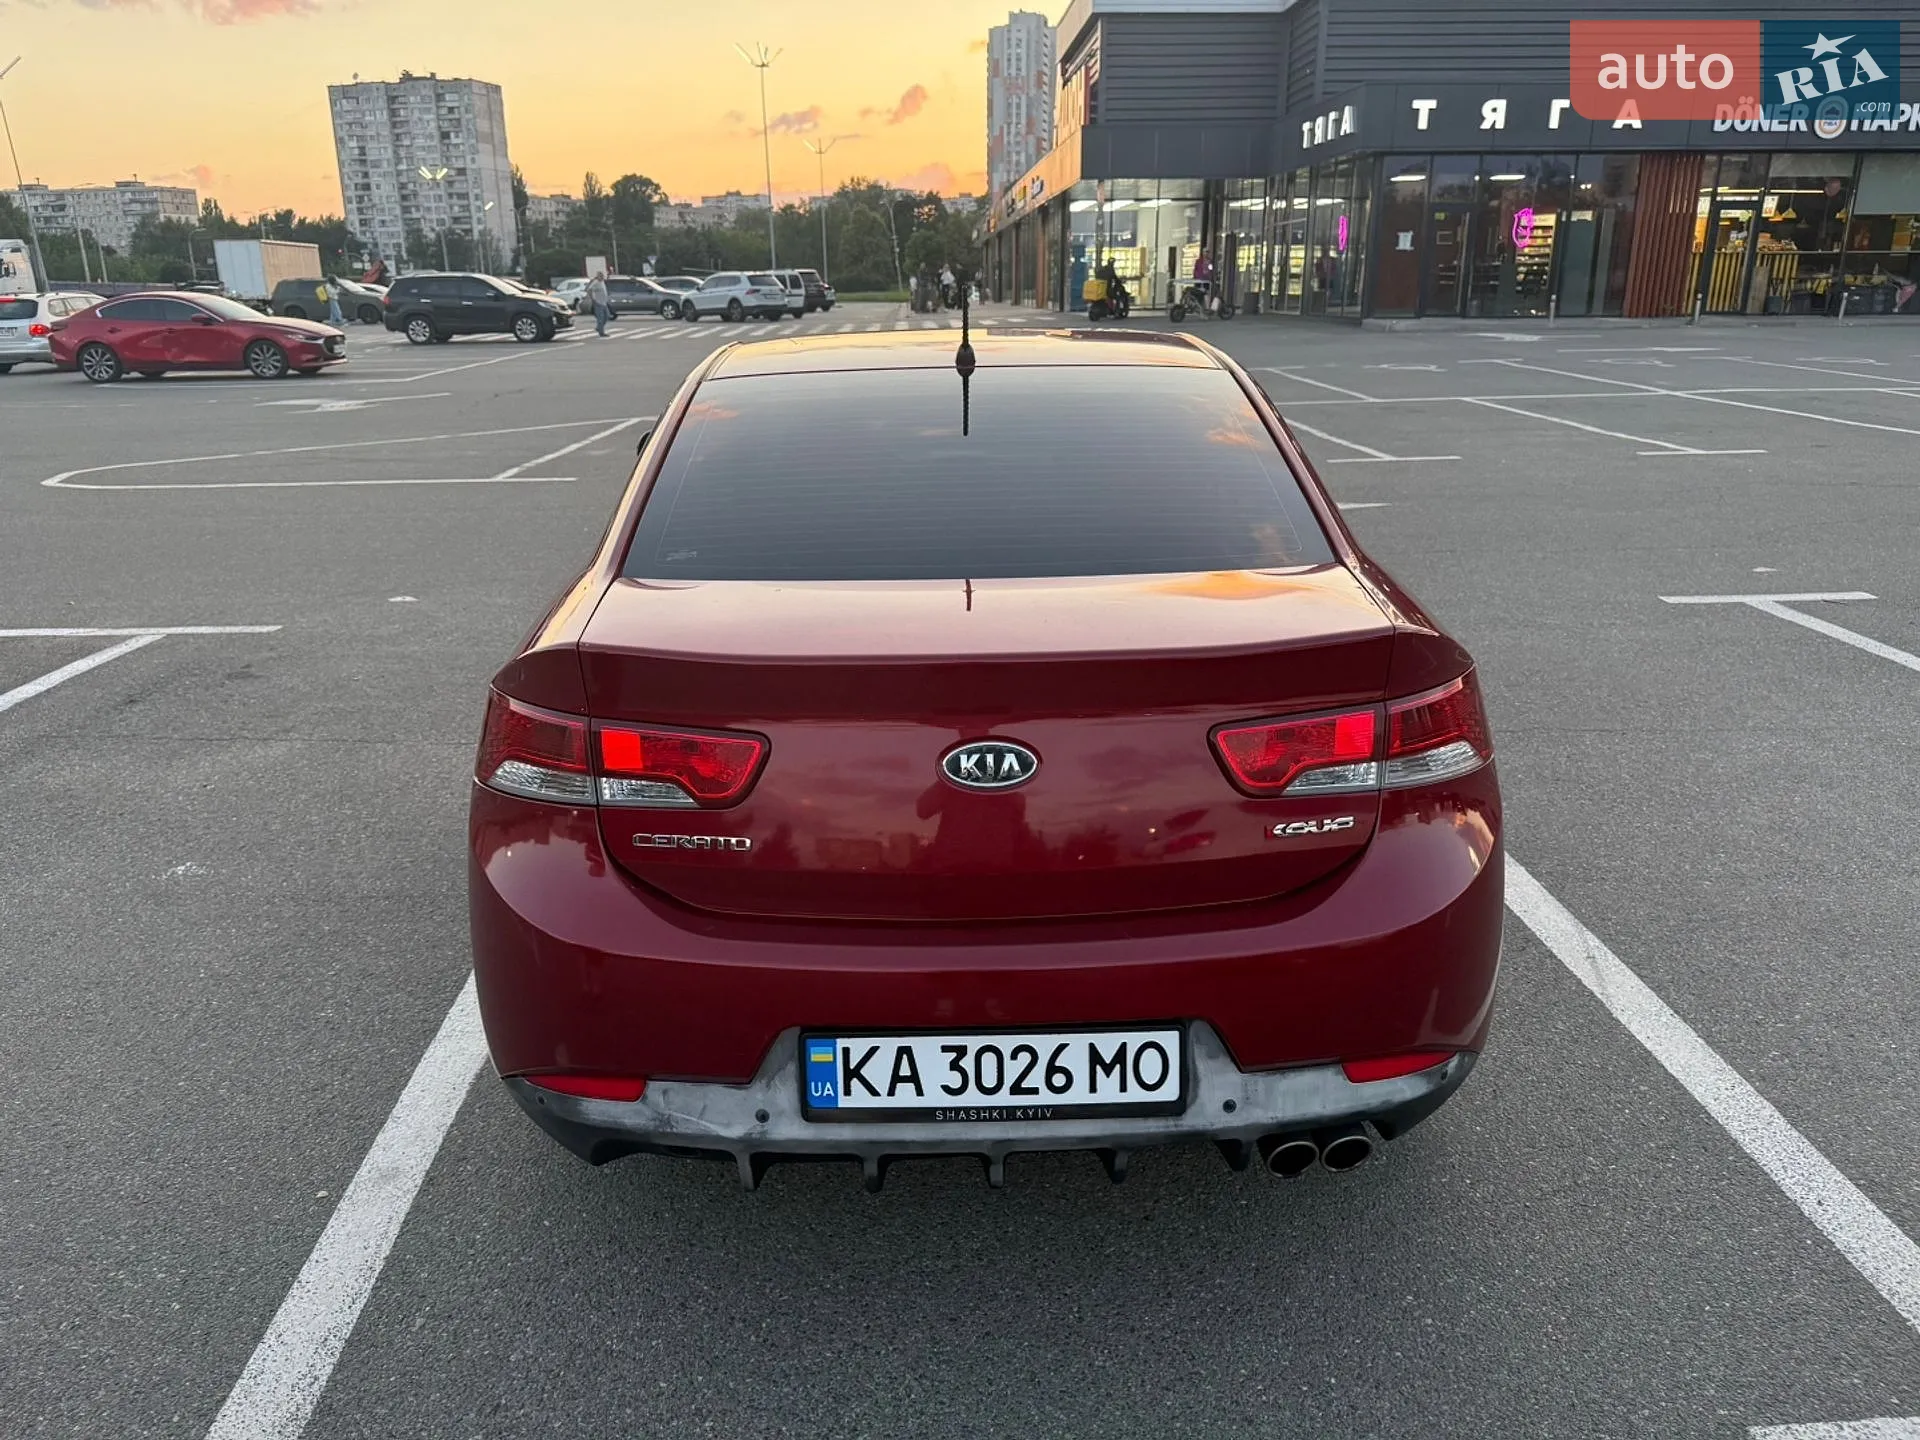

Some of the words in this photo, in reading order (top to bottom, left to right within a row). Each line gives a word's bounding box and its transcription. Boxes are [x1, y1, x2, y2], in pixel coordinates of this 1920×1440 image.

[1302, 105, 1358, 149] ТЯГА
[1411, 99, 1643, 130] ТЯГА
[1713, 96, 1809, 132] DÖNER
[959, 753, 1023, 779] KIA
[632, 833, 751, 851] CERATO
[841, 1045, 925, 1098] KA
[940, 1042, 1074, 1097] 3026
[1088, 1040, 1170, 1094] MO
[810, 1080, 835, 1098] UA
